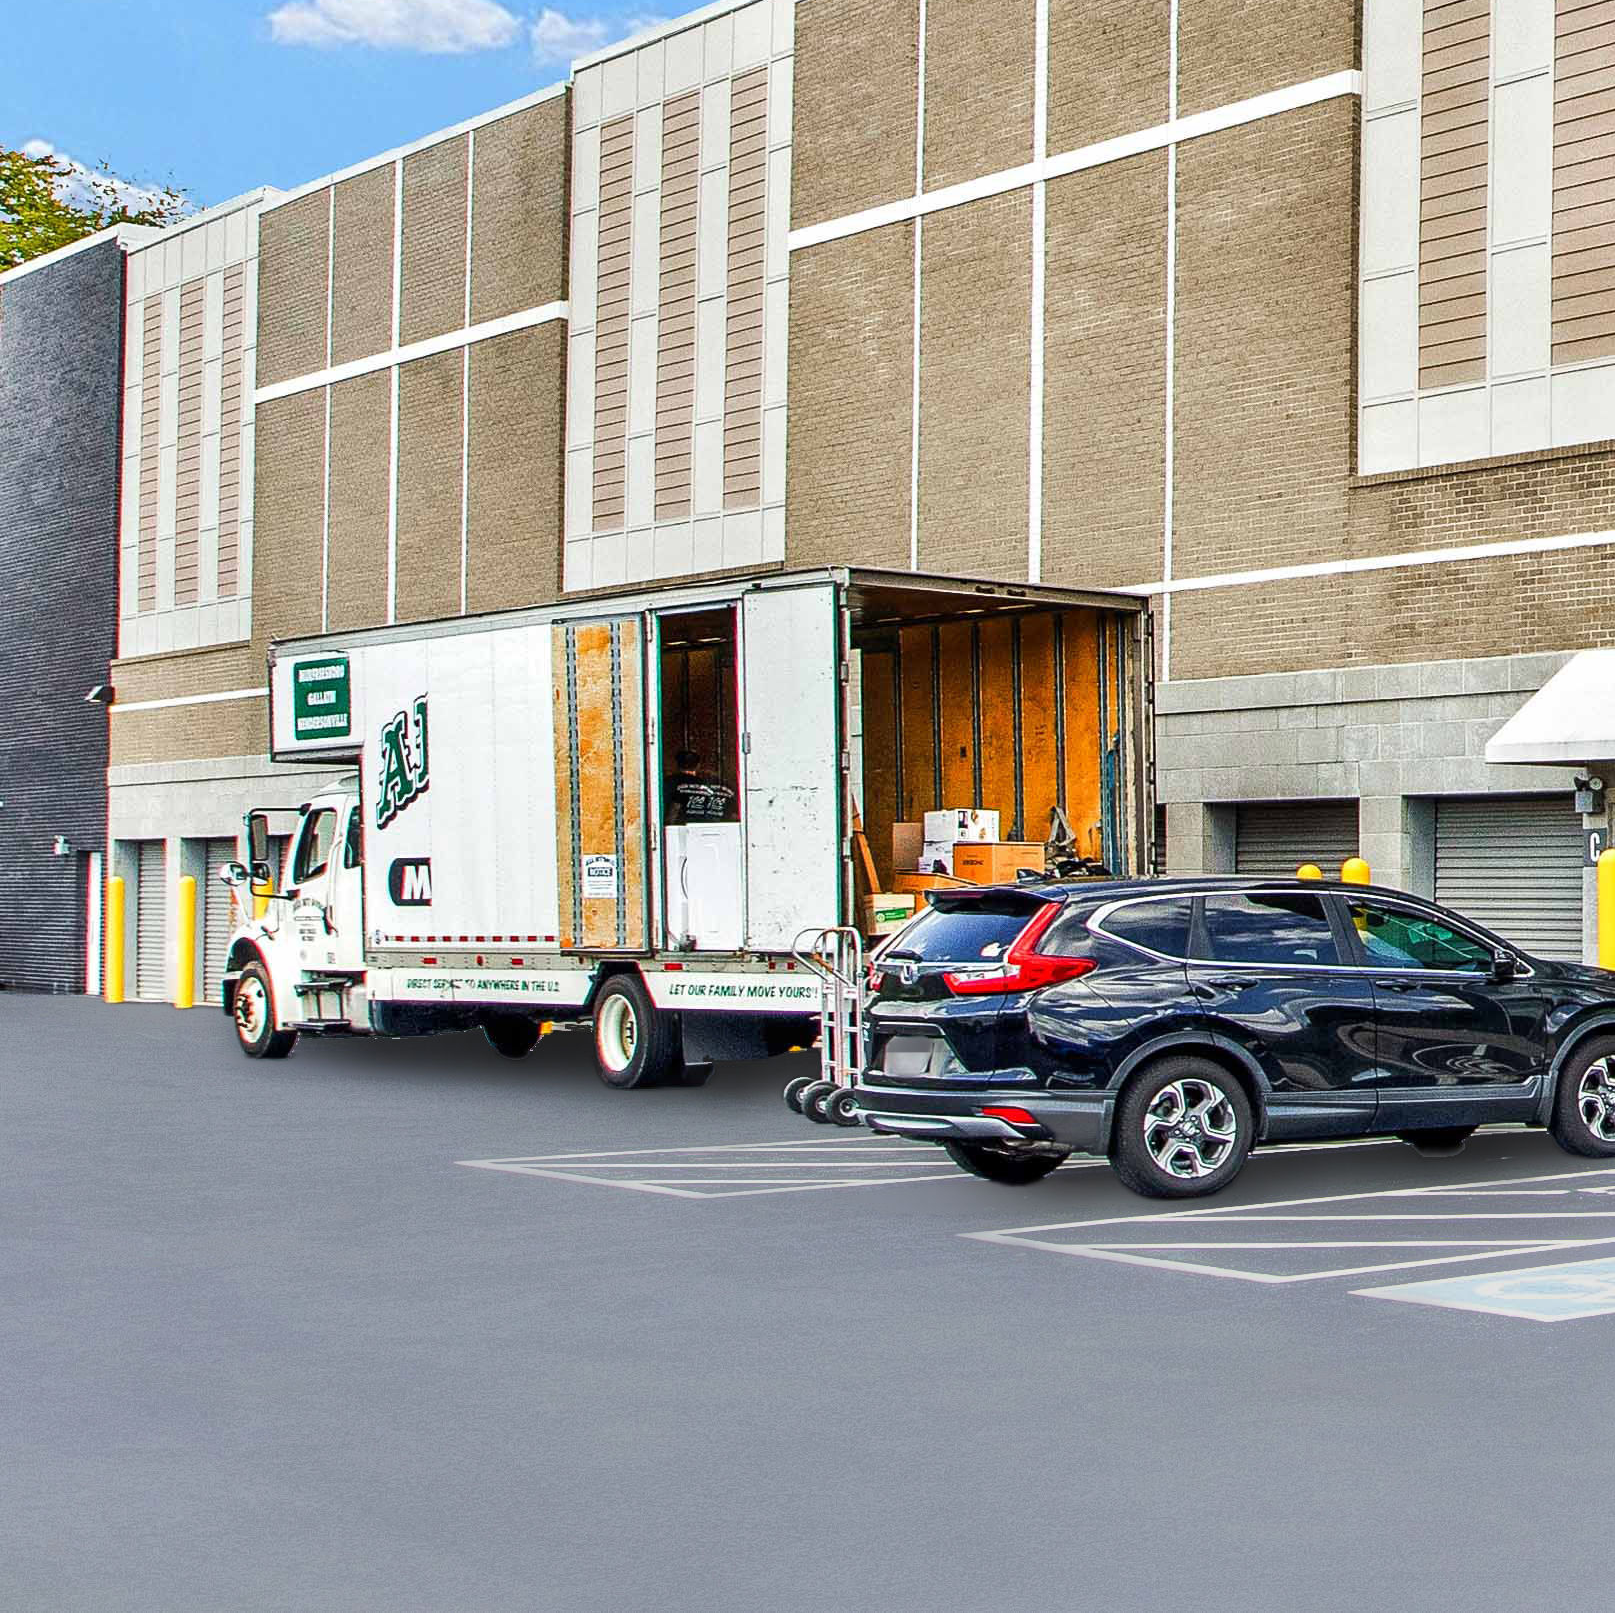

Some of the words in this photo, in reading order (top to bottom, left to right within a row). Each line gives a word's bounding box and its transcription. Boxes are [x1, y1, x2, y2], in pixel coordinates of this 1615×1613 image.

[1590, 832, 1601, 863] C
[477, 978, 519, 990] ANYWHERE
[521, 980, 529, 991] IN
[531, 980, 545, 991] THE
[669, 983, 687, 996] LET
[688, 984, 706, 996] OUR
[708, 985, 746, 997] FAMILY
[746, 985, 776, 997] MOVE
